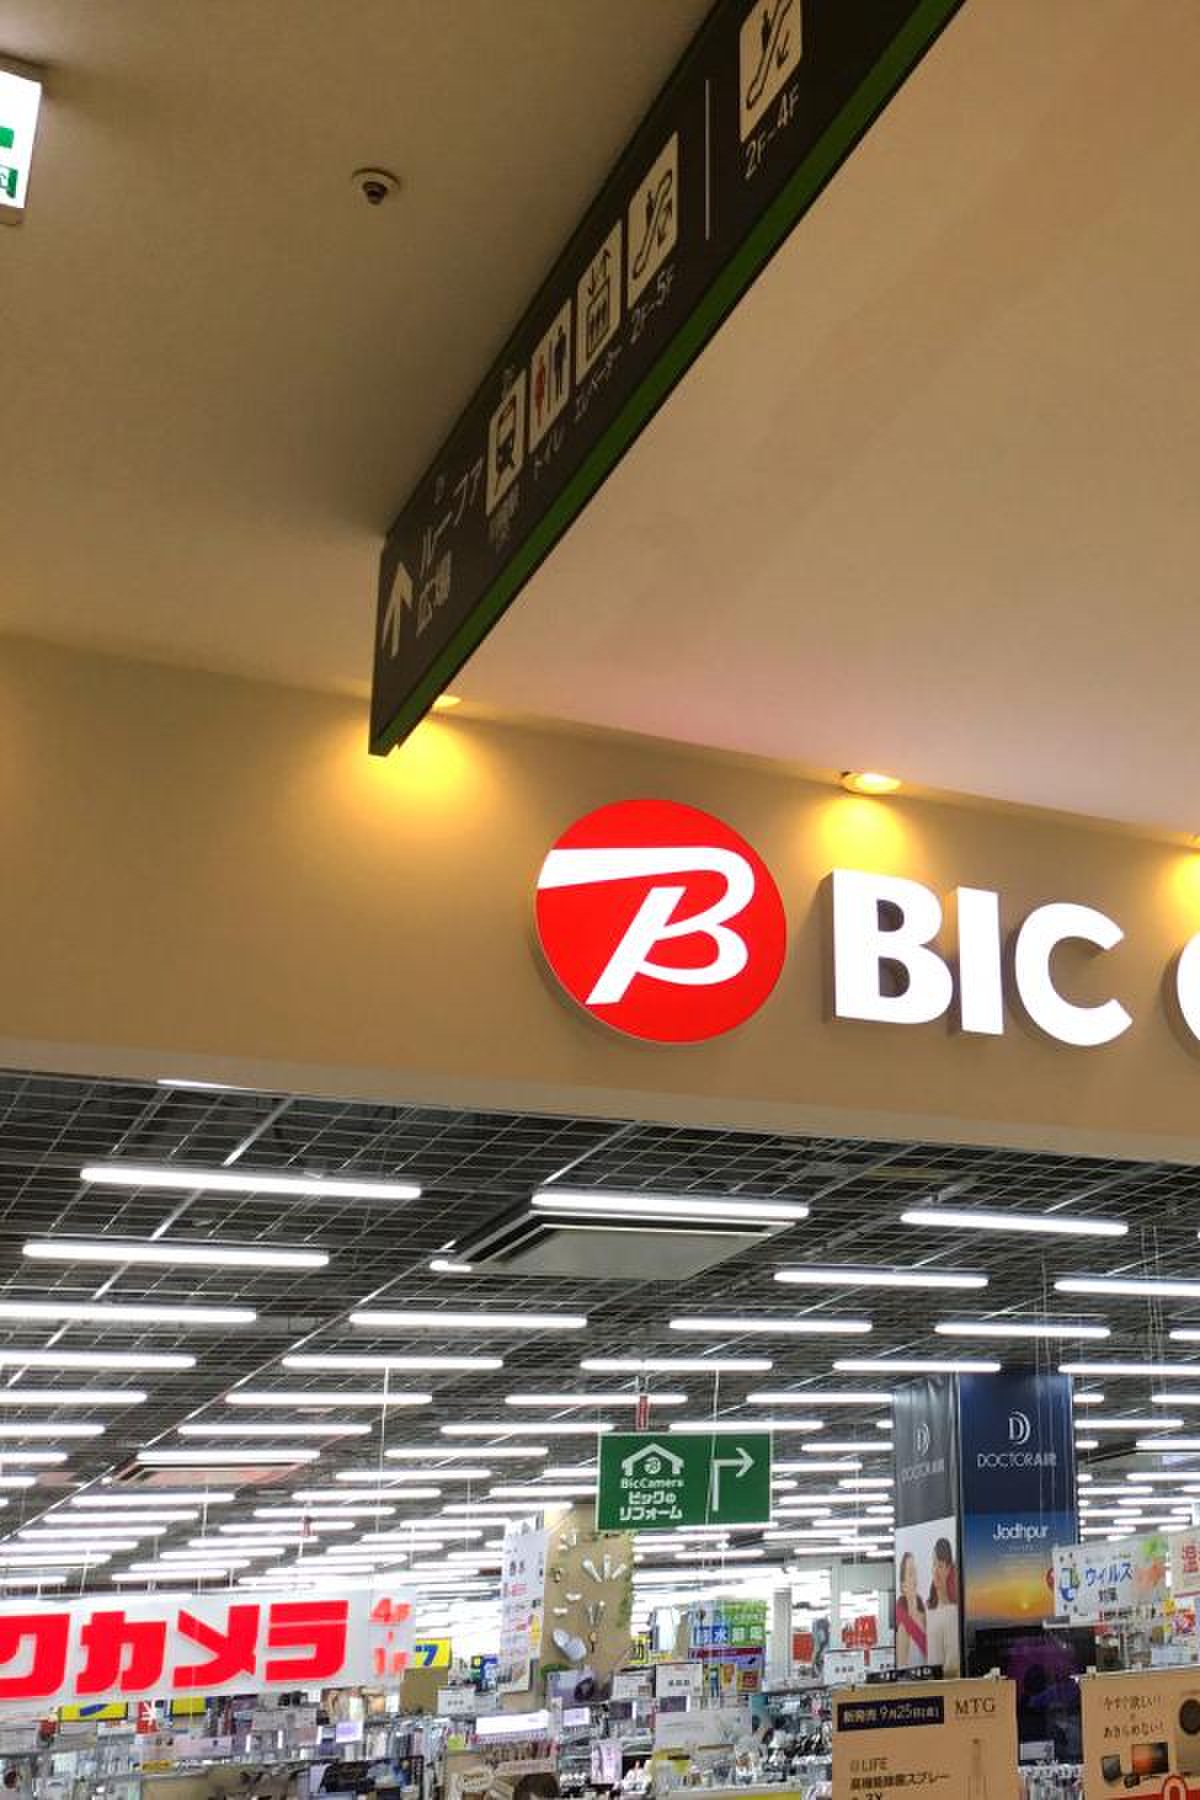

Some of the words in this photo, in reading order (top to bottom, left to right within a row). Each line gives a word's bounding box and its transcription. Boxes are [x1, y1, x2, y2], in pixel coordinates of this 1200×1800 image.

[832, 868, 1133, 1047] BIC
[619, 1505, 683, 1521] リフォーム
